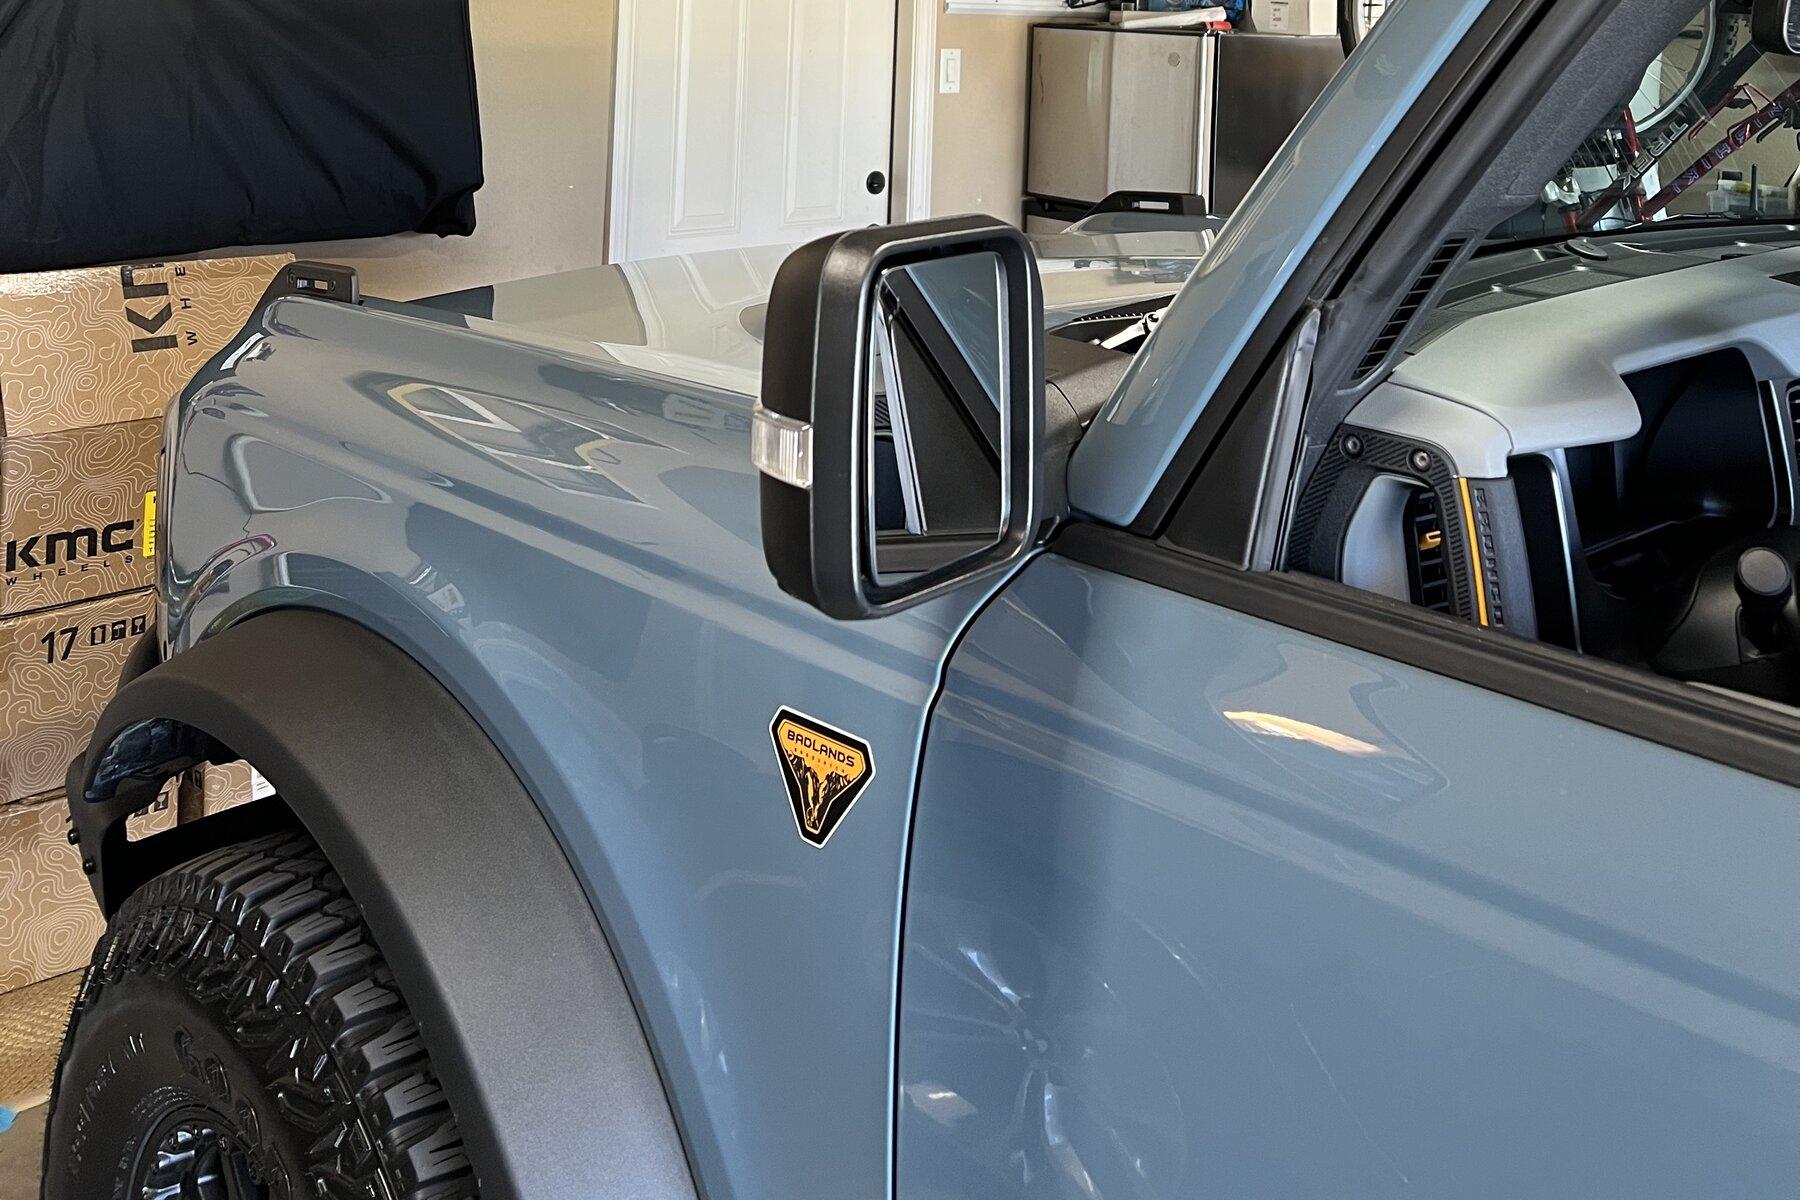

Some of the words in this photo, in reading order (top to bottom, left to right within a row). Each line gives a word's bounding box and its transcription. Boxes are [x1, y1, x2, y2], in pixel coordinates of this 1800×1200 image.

[1622, 122, 1689, 191] TREK
[5, 555, 133, 586] WHEELS
[40, 626, 79, 664] 17
[787, 729, 855, 767] BADLANDS
